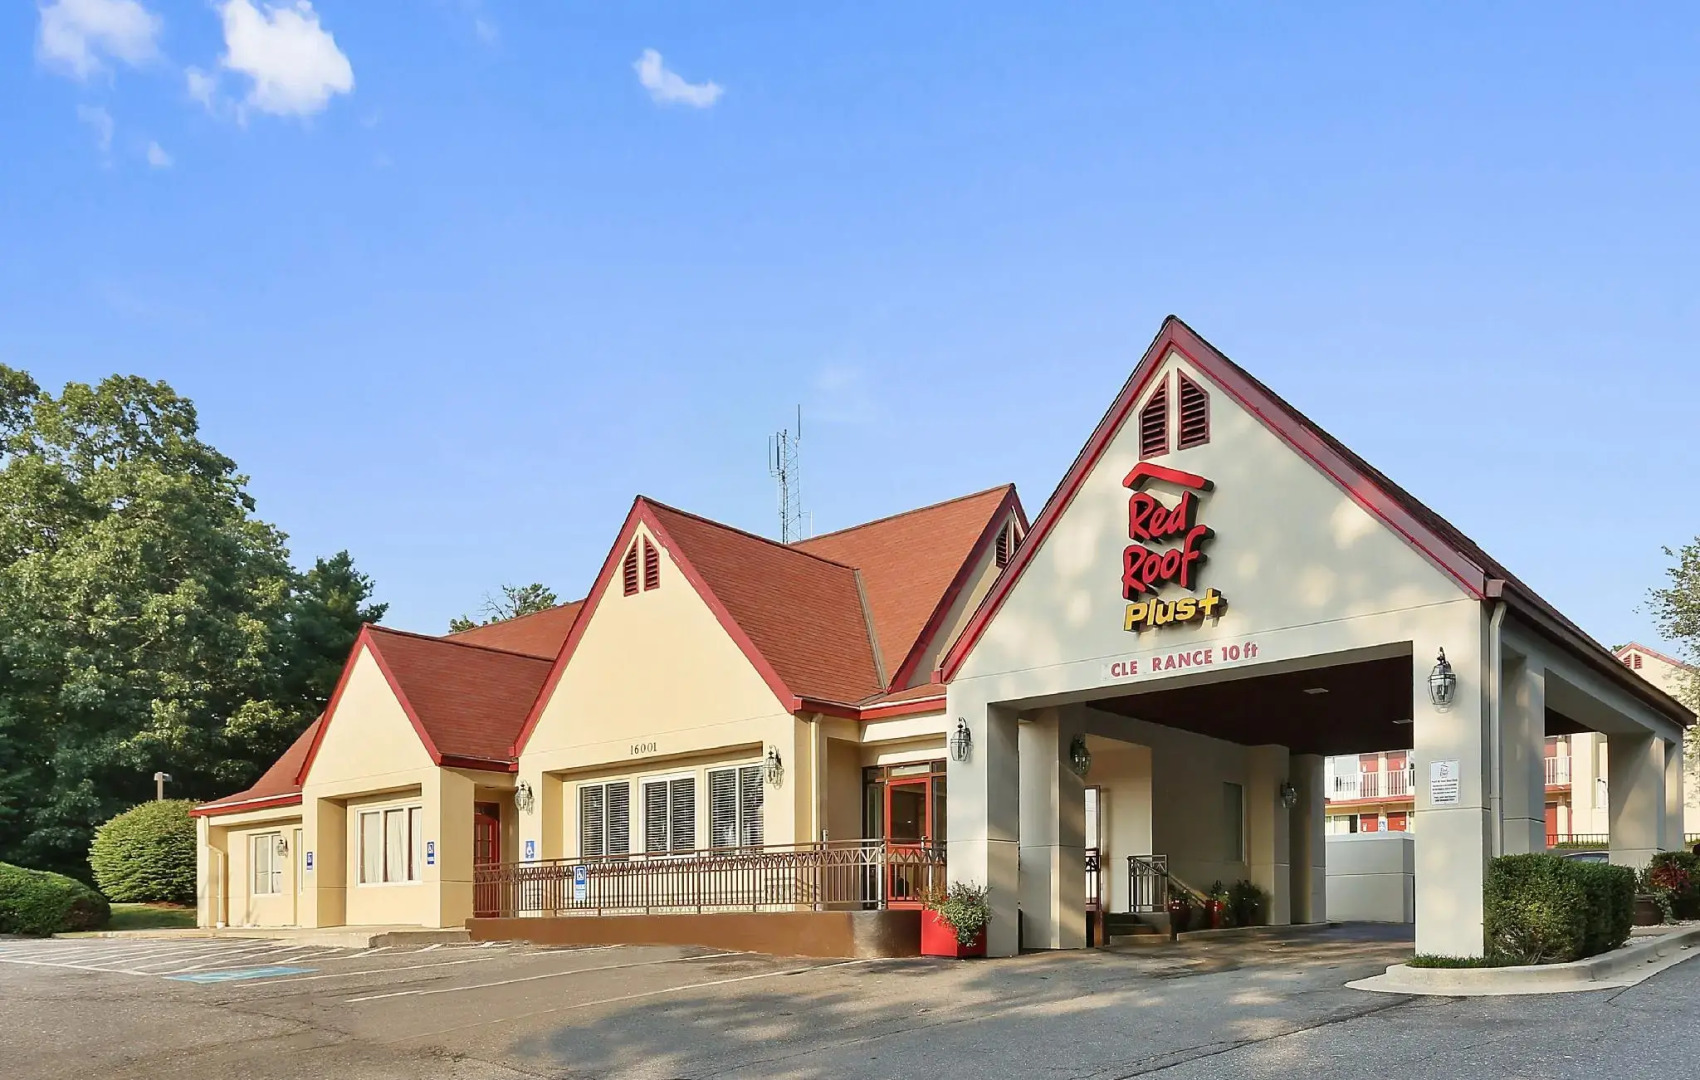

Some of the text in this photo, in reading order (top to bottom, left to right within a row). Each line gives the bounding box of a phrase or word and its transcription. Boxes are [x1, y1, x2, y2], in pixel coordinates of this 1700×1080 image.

[1129, 491, 1192, 541] Red
[1122, 524, 1208, 600] Roof
[1124, 588, 1221, 631] Plus+
[630, 742, 657, 755] 16001
